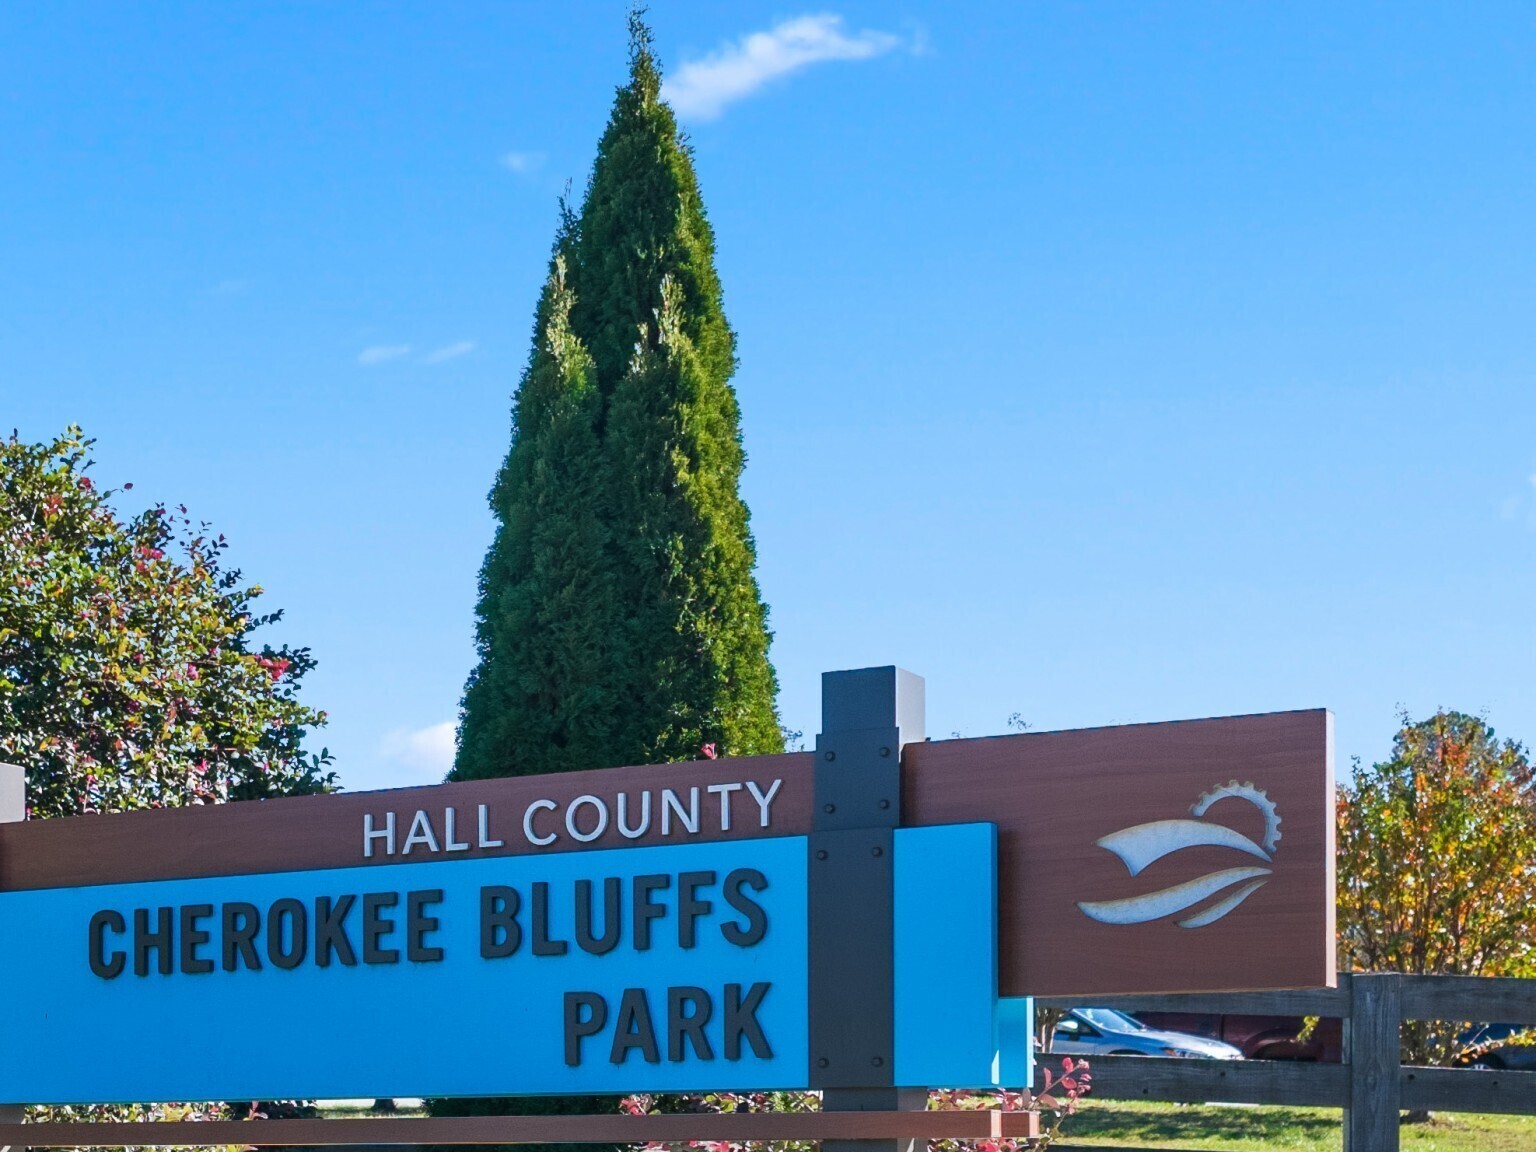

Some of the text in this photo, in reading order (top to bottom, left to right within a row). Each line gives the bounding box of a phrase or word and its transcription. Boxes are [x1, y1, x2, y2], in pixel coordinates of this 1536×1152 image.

[362, 778, 784, 857] HALL COUNTY
[88, 868, 769, 979] CHEROKEE BLUFFS
[564, 982, 774, 1066] PARK
